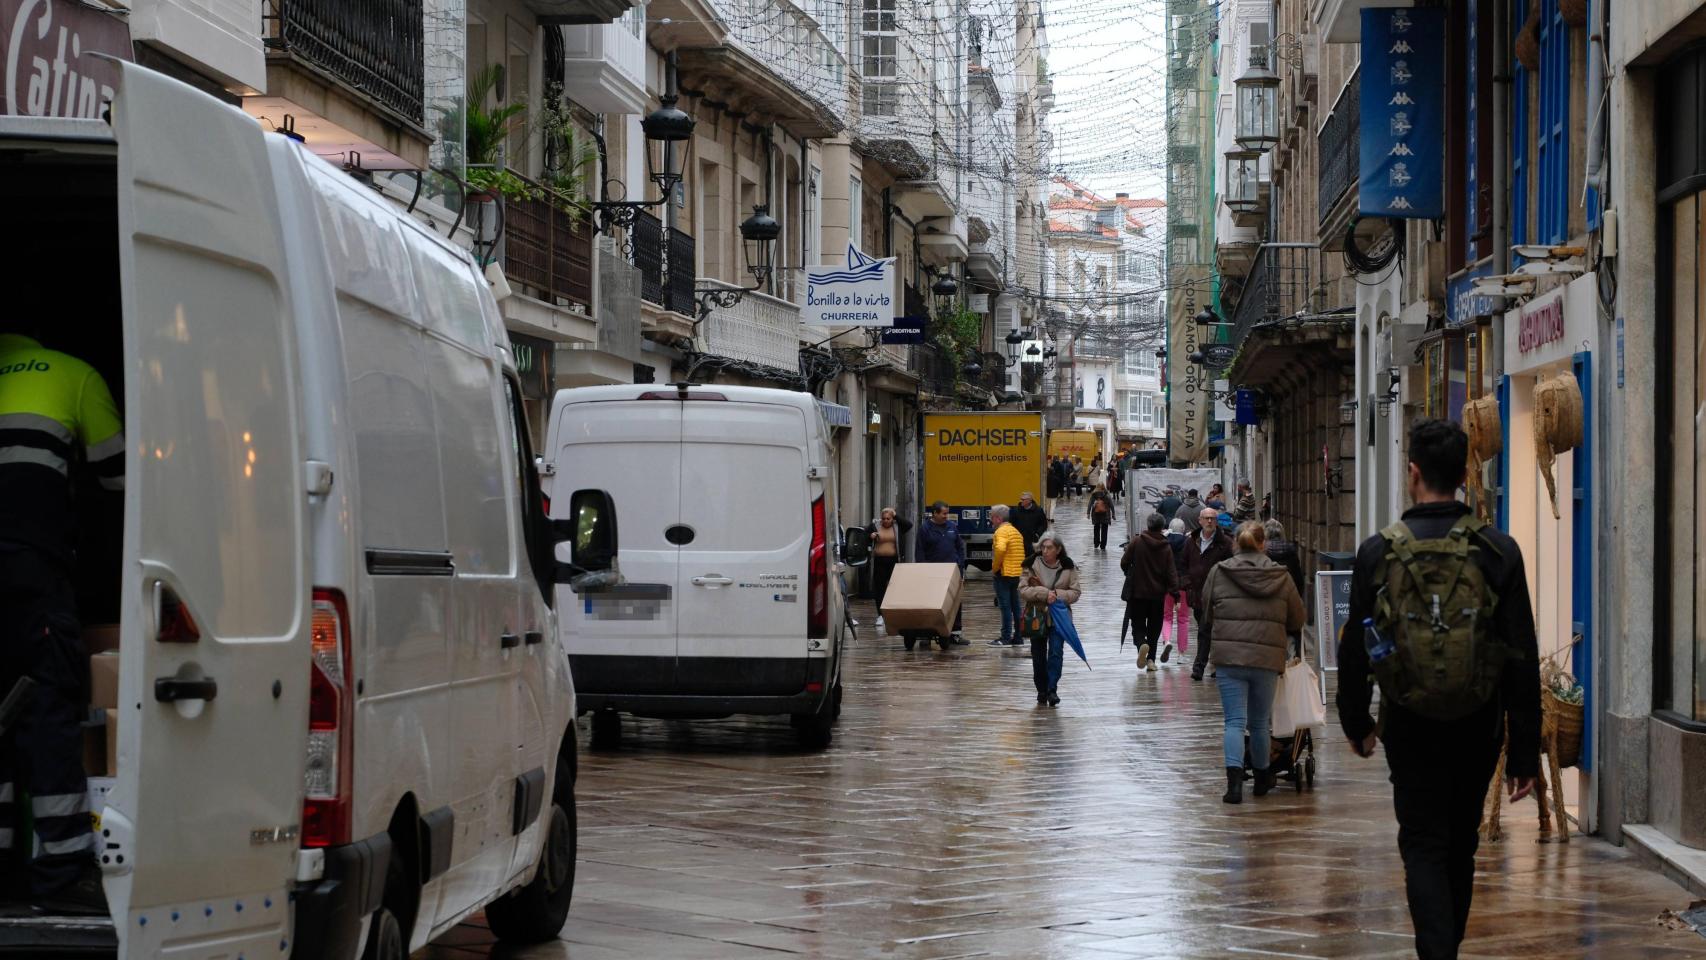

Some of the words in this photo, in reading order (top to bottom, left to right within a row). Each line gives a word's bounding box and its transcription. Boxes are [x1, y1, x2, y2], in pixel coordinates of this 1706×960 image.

[807, 284, 841, 306] Bonilla
[844, 296, 850, 306] a
[853, 291, 862, 306] la
[864, 292, 890, 306] vista
[820, 310, 879, 321] CHURRERÍA
[1185, 278, 1195, 362] COMPRAMOS
[1185, 365, 1195, 394] ORO
[1185, 398, 1195, 406] Y
[938, 429, 1027, 446] DACHSER
[1185, 409, 1195, 449] PLATA
[939, 453, 984, 463] Intelligent
[986, 454, 1028, 463] Logistics
